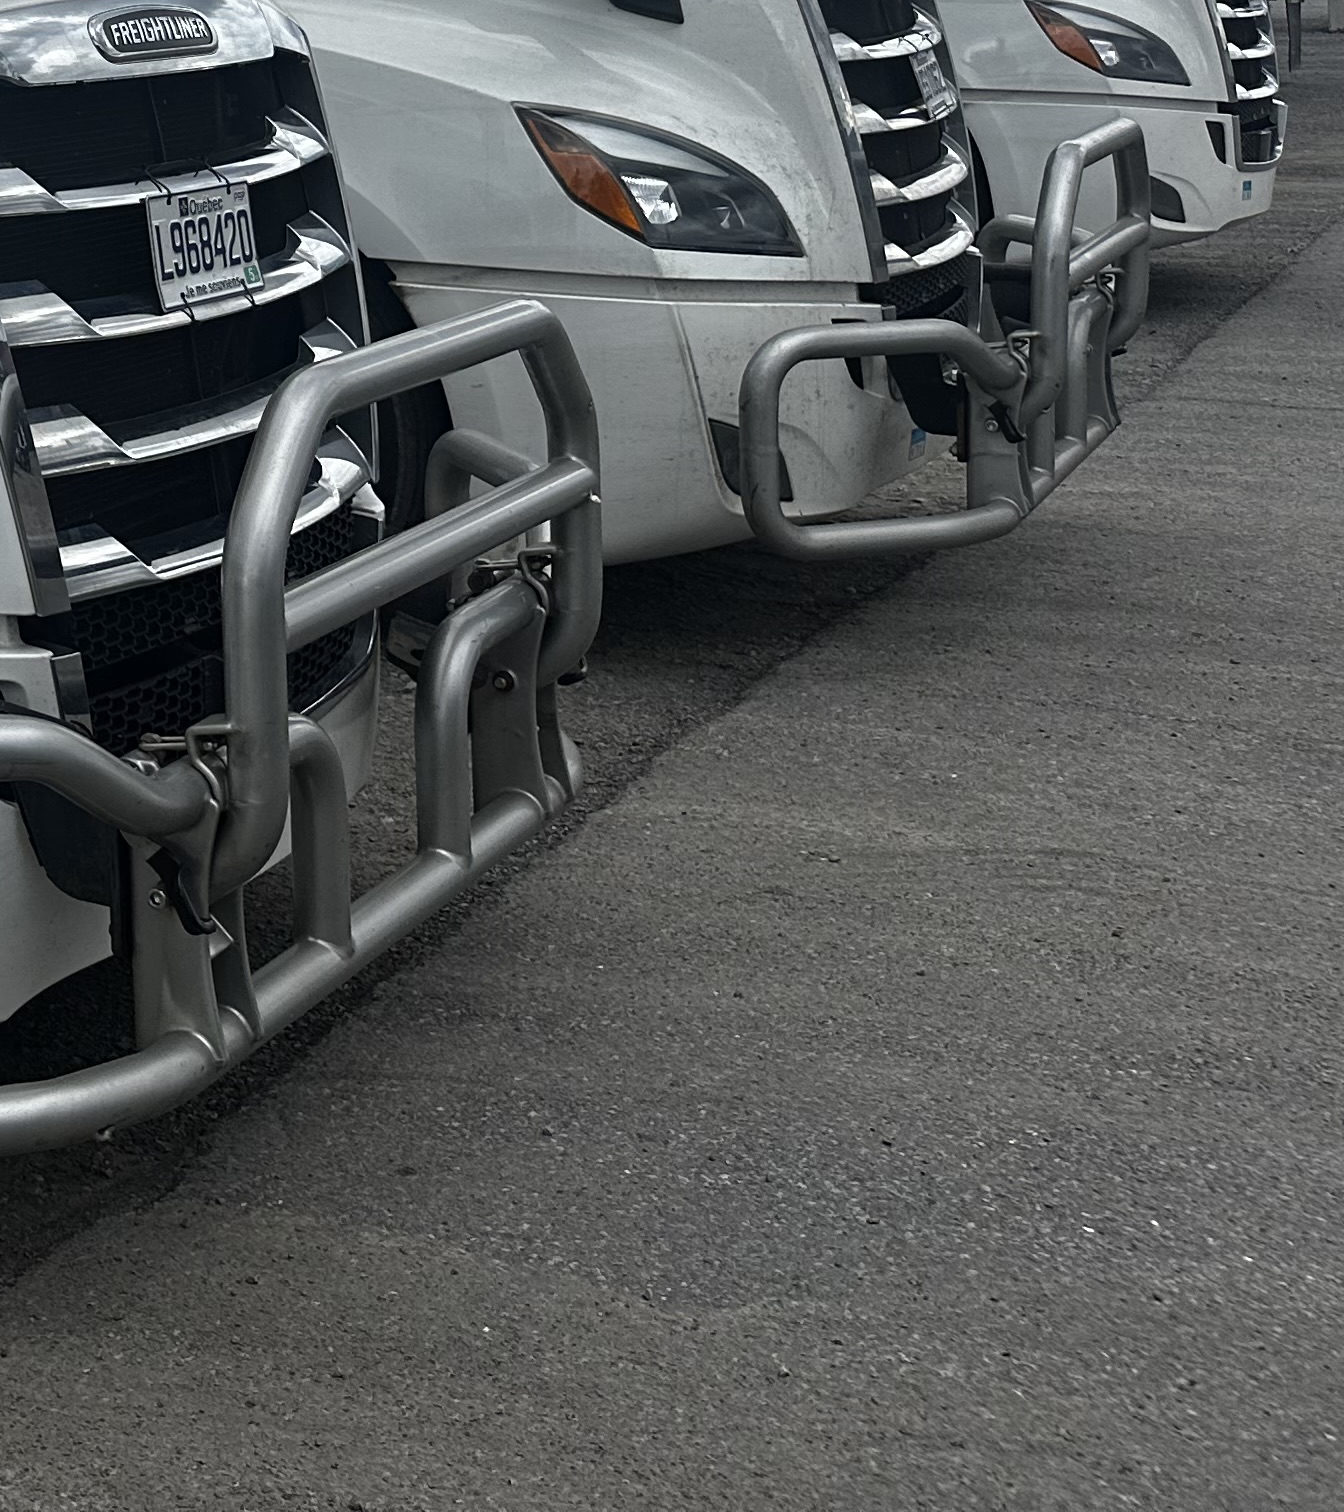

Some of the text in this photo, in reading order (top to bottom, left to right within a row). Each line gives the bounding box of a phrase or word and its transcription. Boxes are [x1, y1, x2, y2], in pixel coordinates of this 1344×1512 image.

[110, 15, 209, 46] FREIGHTLINER
[154, 209, 254, 282] L968420
[248, 268, 256, 282] 5
